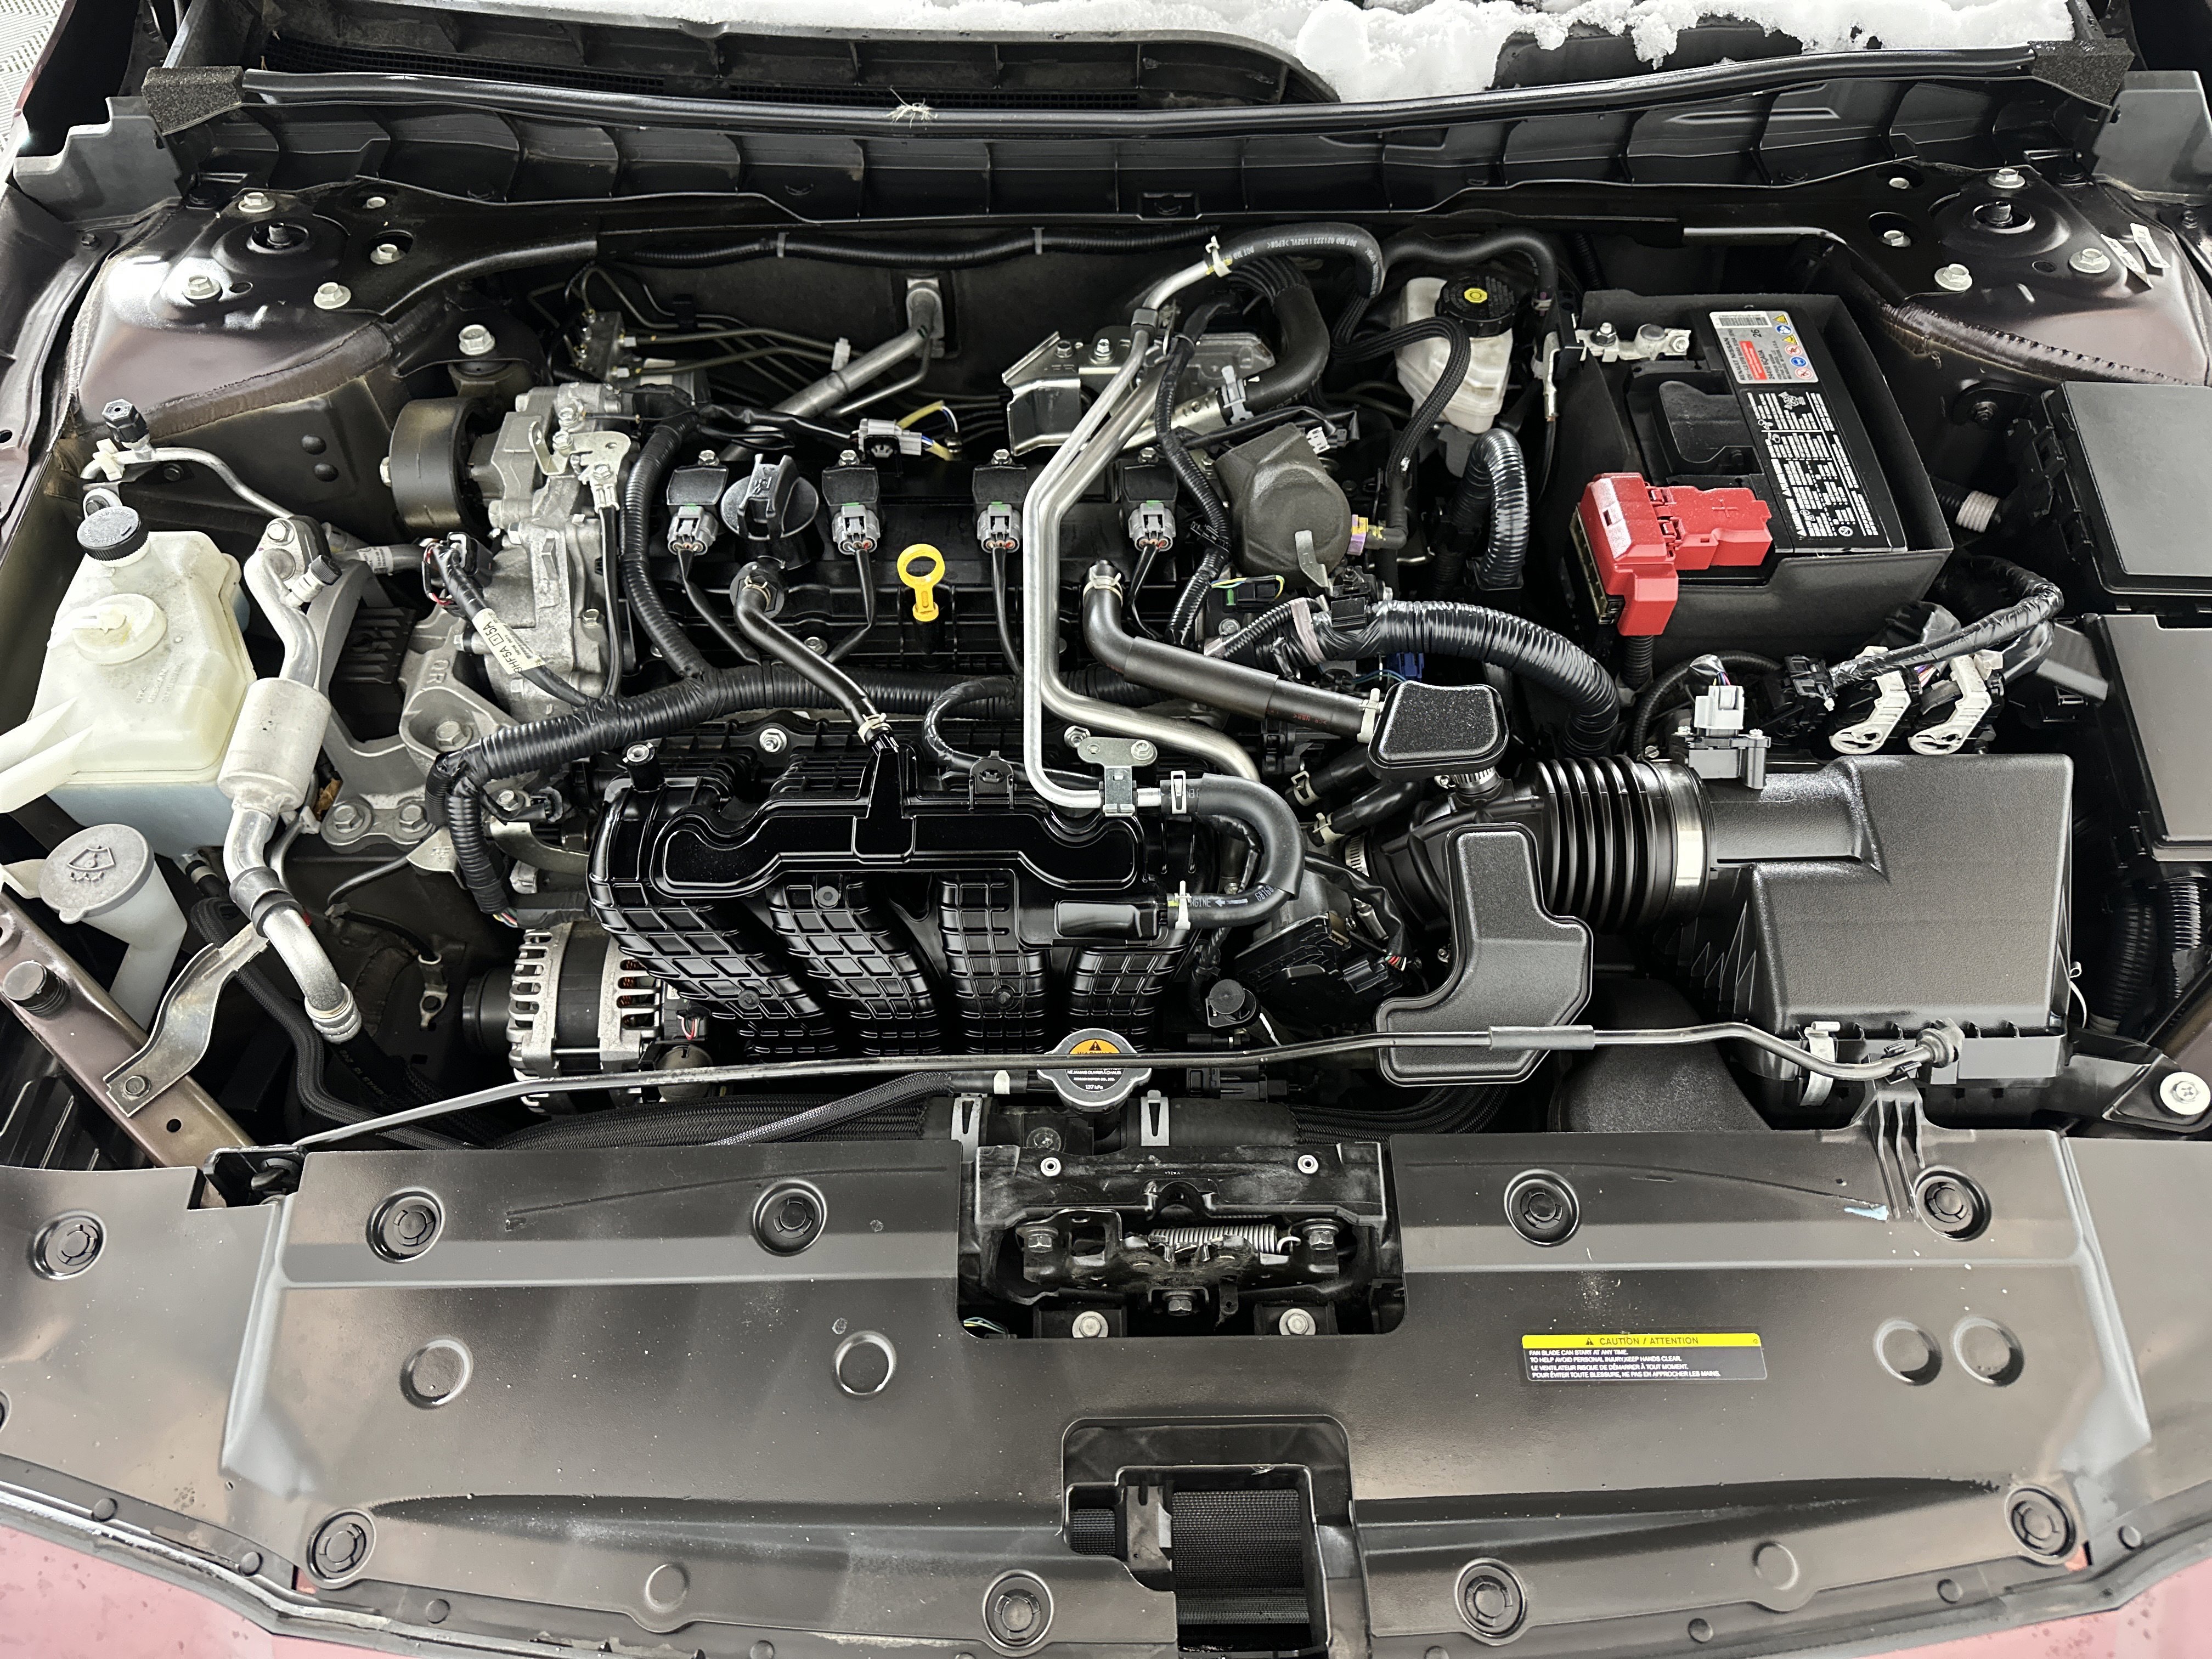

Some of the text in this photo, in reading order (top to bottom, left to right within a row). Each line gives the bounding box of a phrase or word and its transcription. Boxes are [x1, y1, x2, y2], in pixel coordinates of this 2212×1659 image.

[1751, 329, 1762, 338] 26
[1723, 337, 1745, 381] RENAULT NISSAN
[483, 621, 497, 636] 5A
